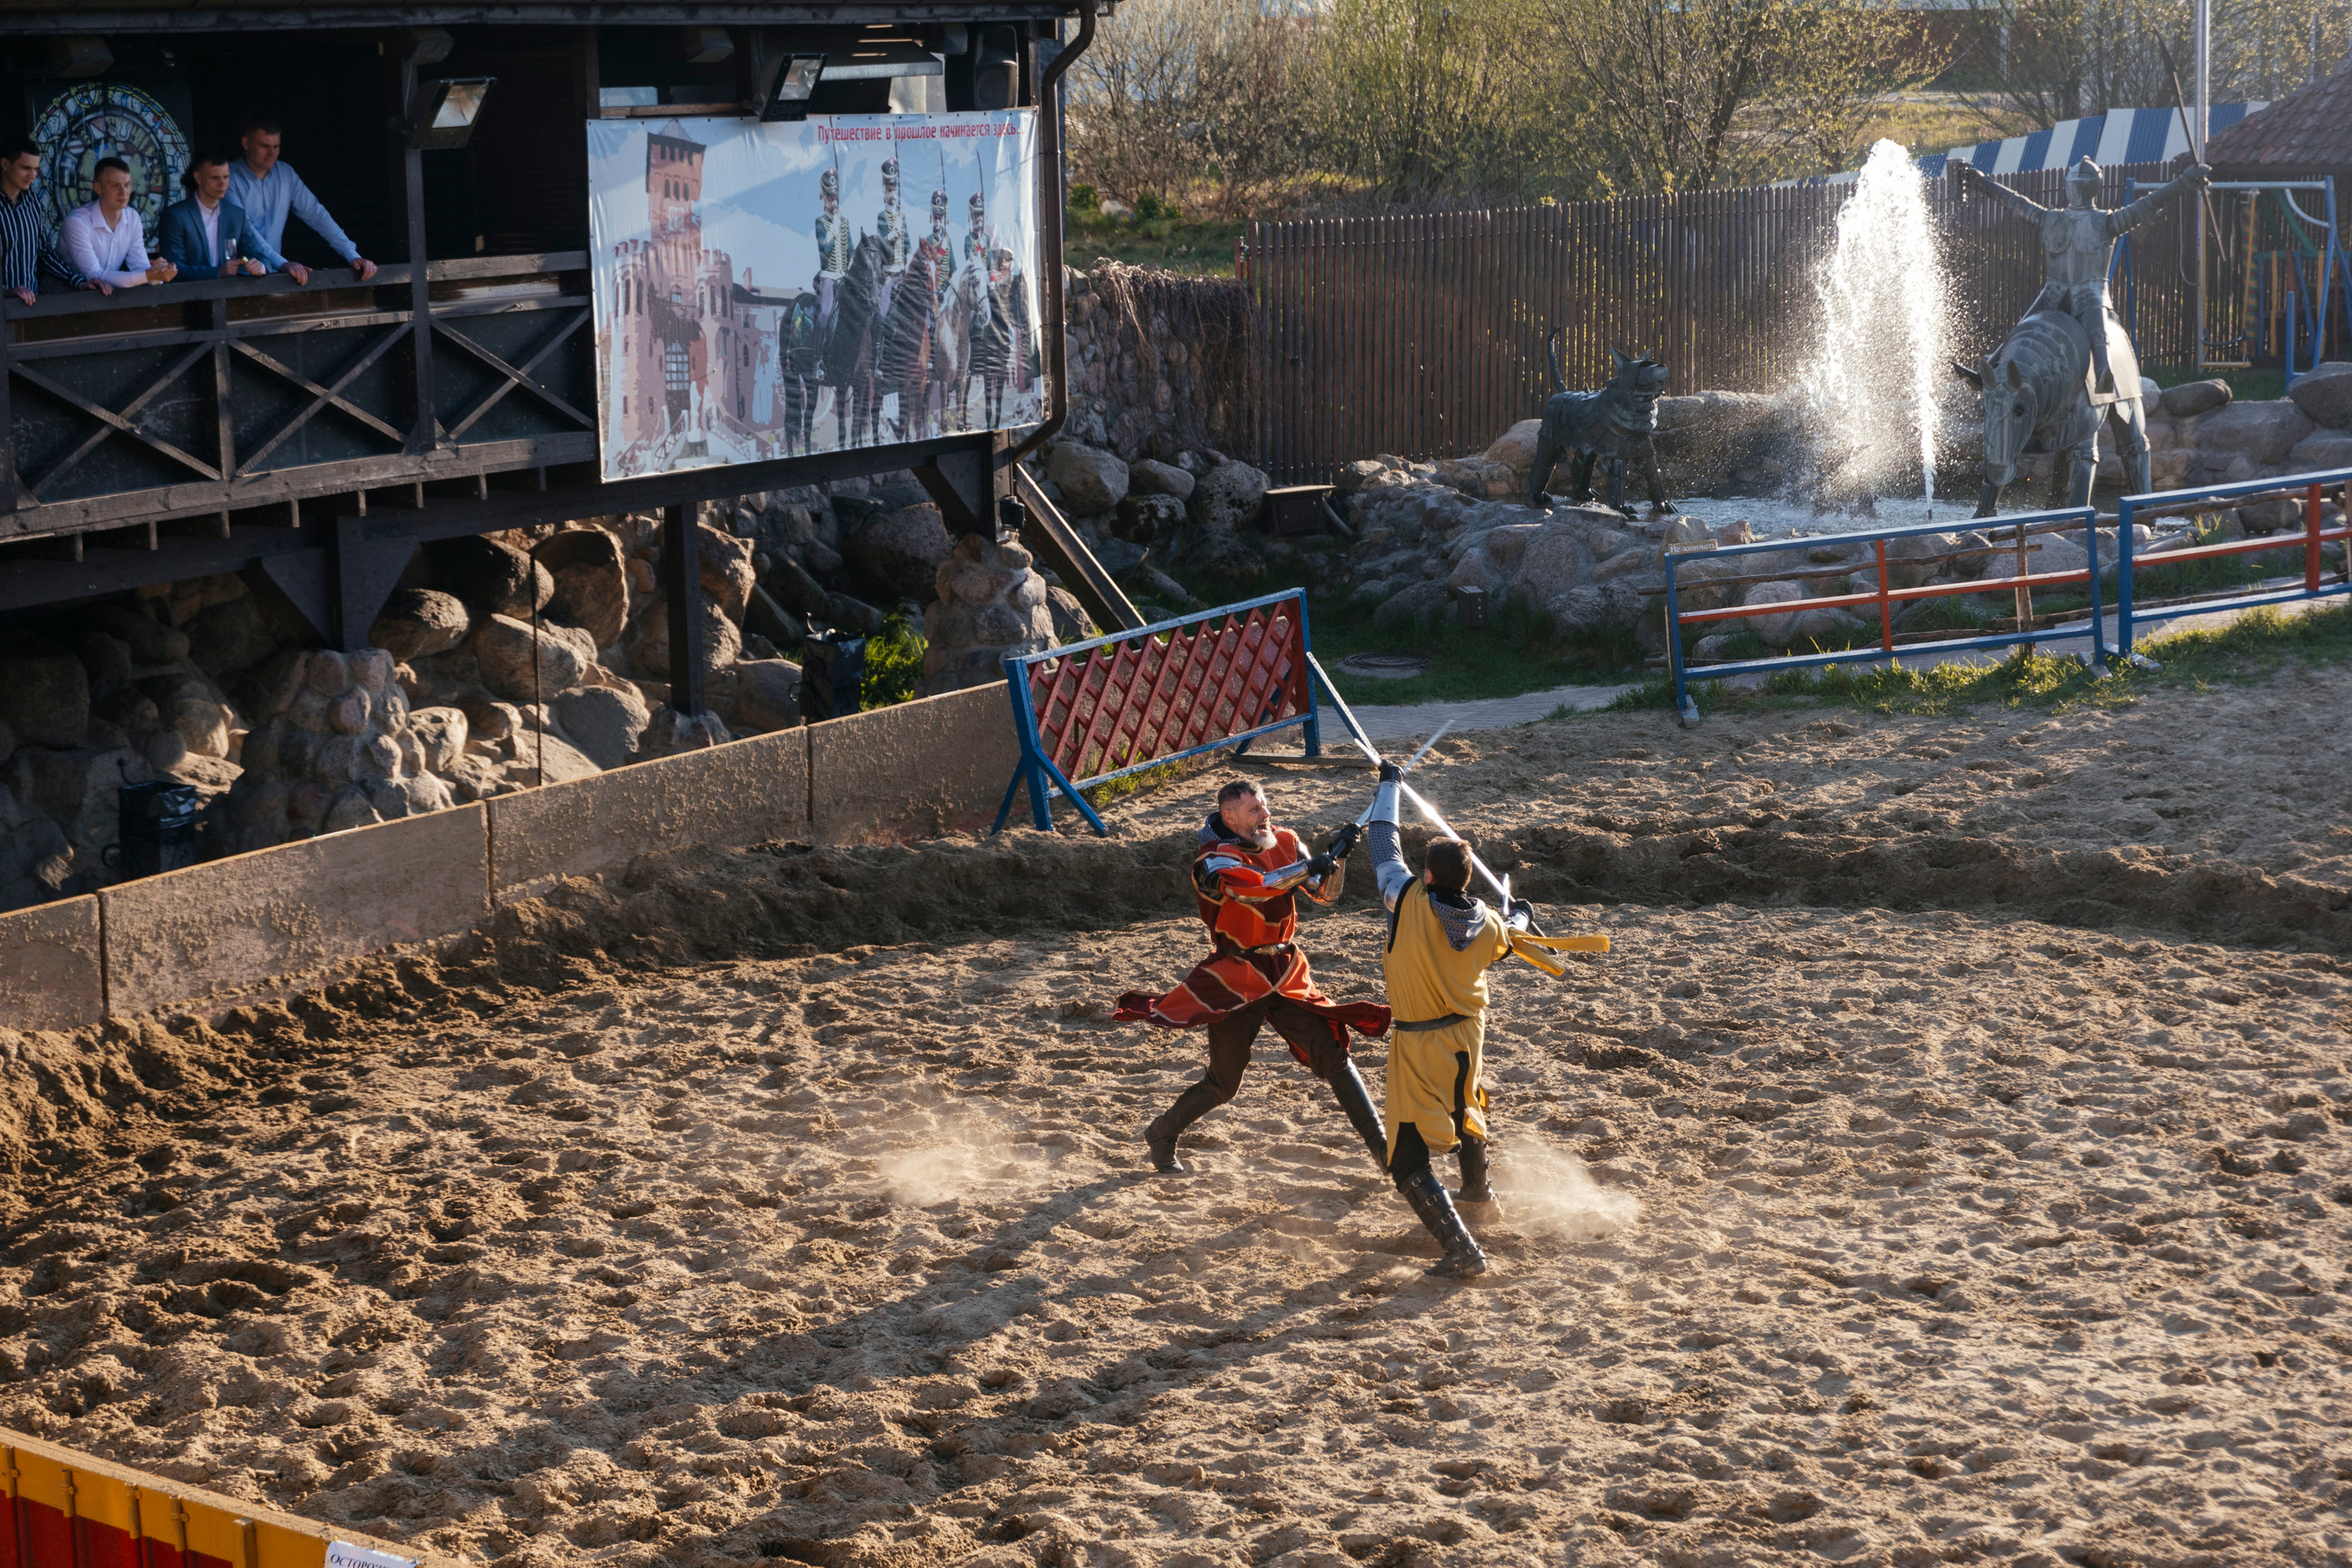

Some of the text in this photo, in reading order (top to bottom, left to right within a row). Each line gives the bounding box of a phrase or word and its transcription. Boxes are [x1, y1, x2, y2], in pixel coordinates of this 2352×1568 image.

[818, 125, 882, 144] Путешествие
[886, 127, 891, 141] в
[895, 126, 936, 142] прошлое
[940, 123, 990, 138] начинается
[1669, 545, 1680, 553] Не
